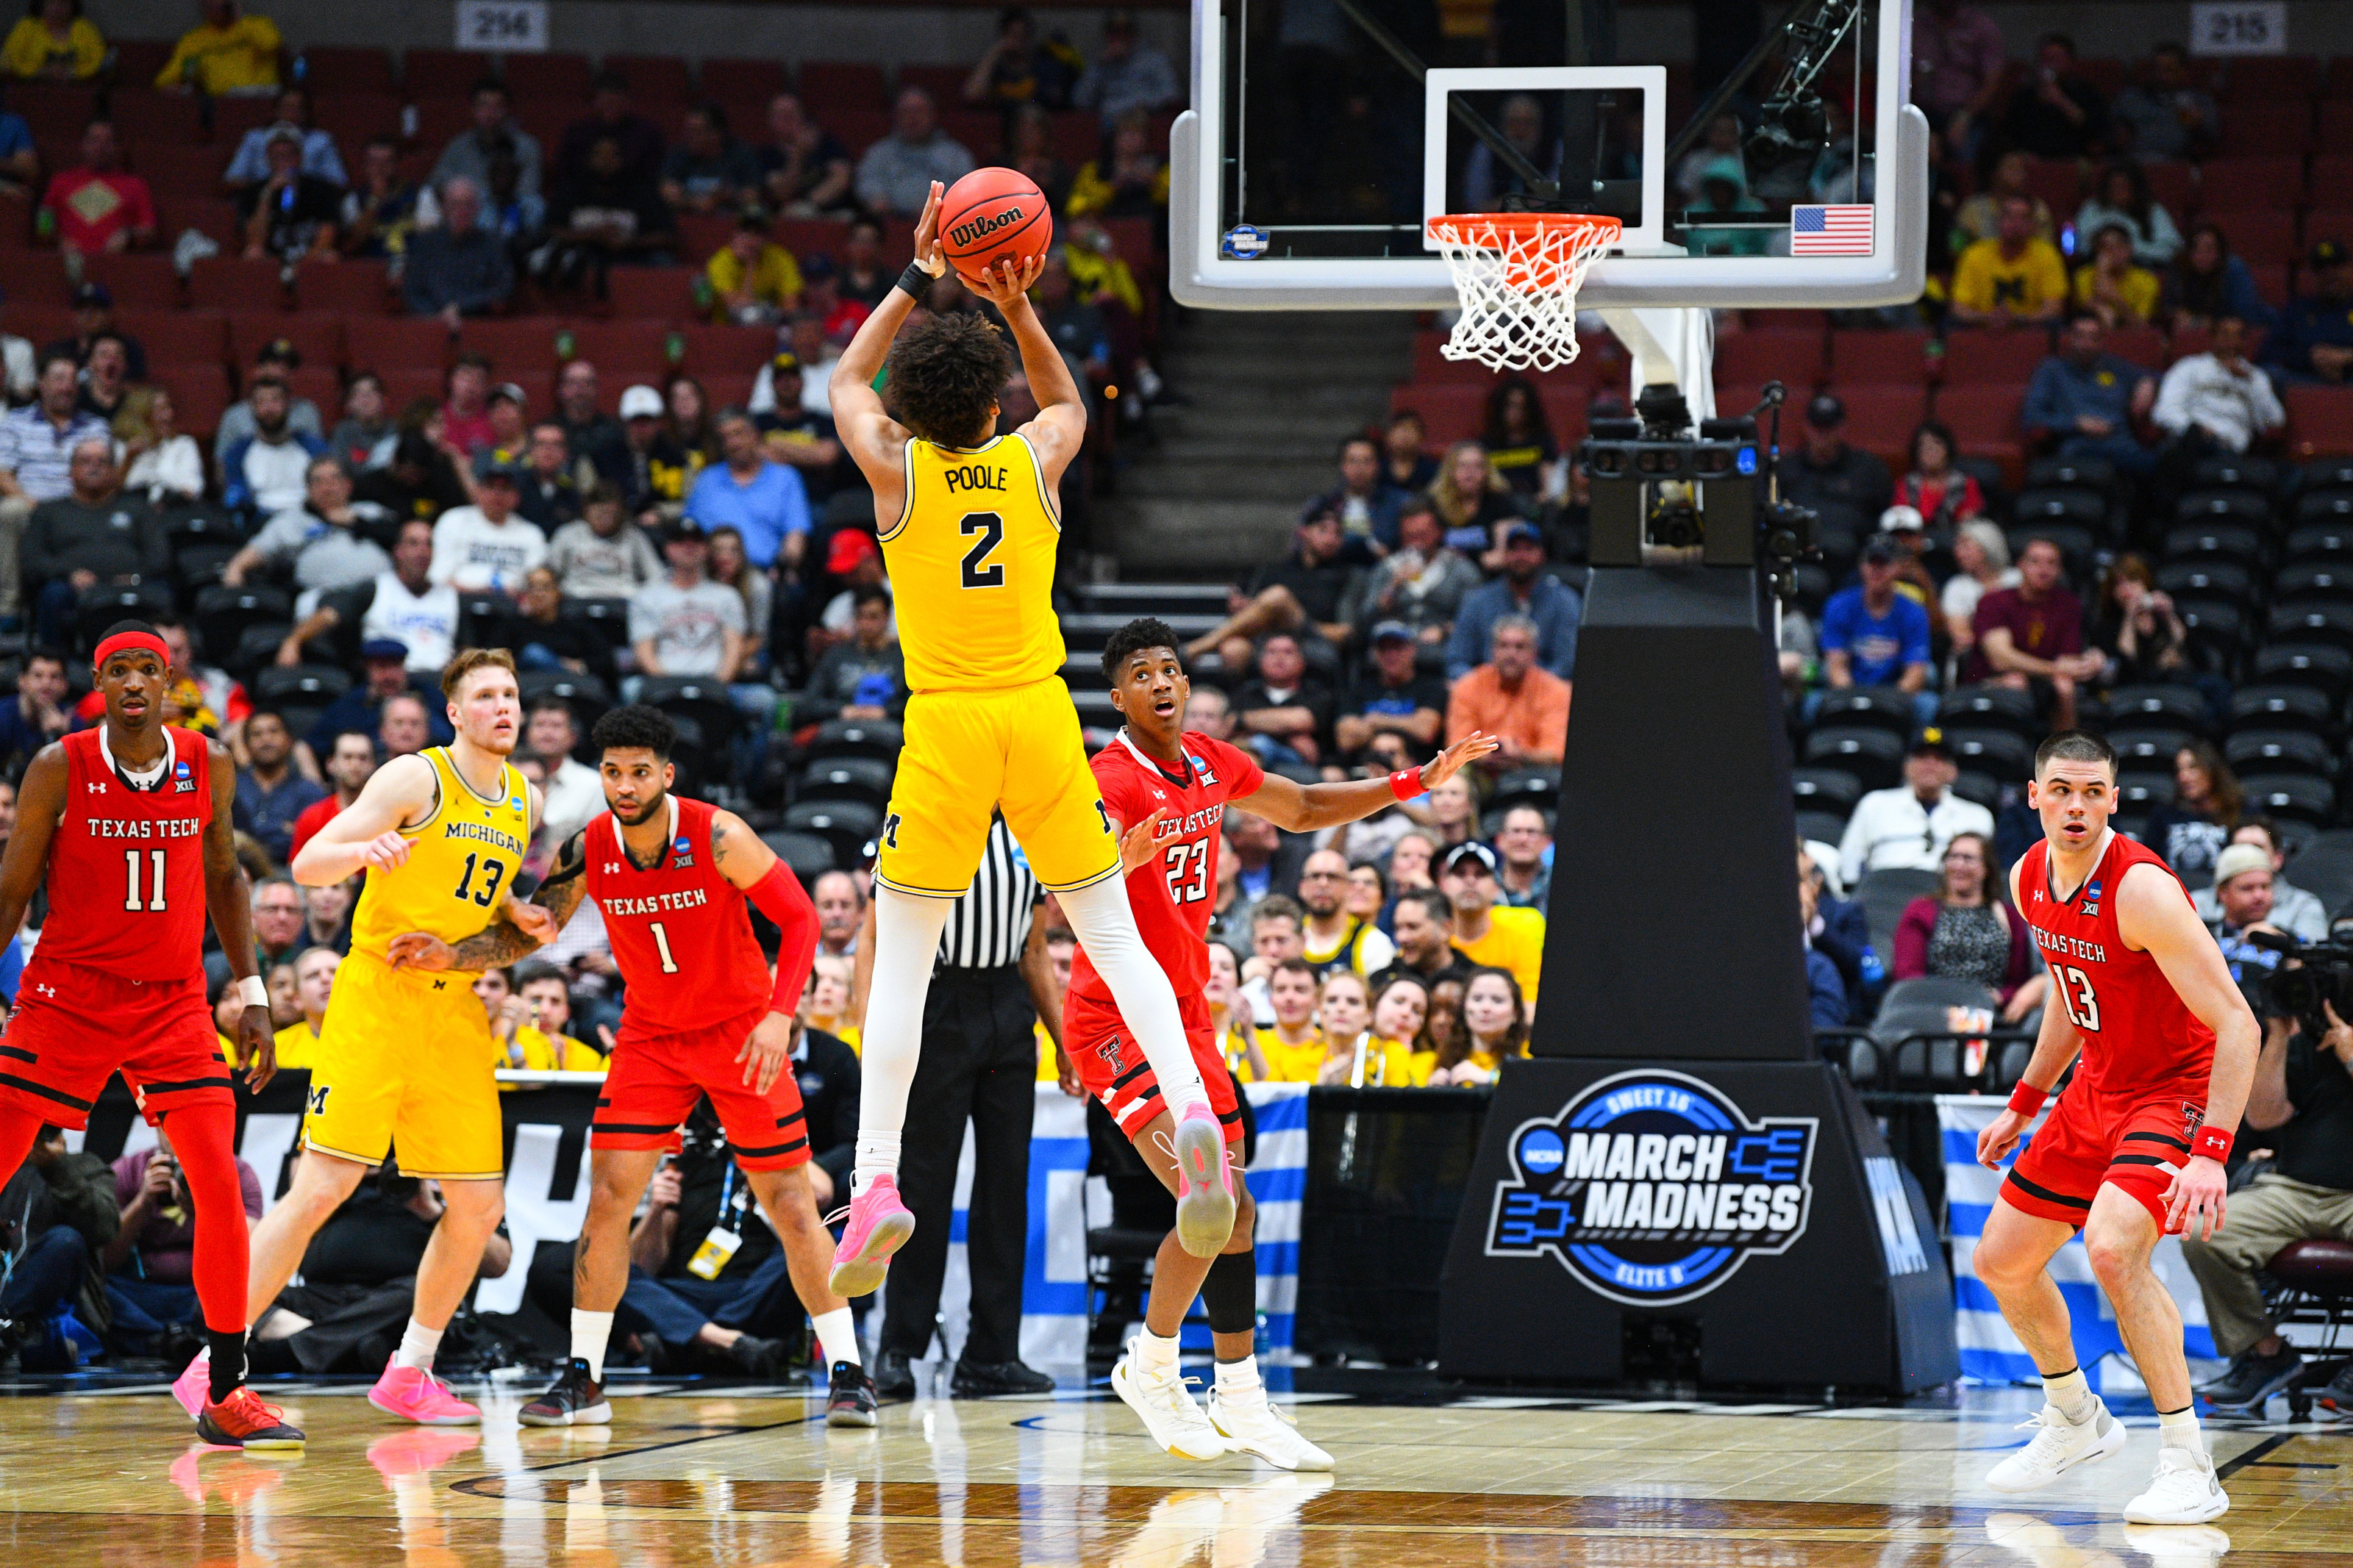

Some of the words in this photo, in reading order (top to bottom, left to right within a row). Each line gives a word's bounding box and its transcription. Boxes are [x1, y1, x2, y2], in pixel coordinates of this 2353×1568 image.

[2210, 11, 2267, 43] 215
[950, 207, 1024, 248] Wilson
[944, 465, 1007, 493] POOLE
[959, 511, 1004, 589] 2
[88, 818, 151, 838] TEXAS
[156, 817, 199, 838] TECH
[1157, 812, 1197, 837] TEXAS
[1196, 801, 1224, 829] TECH
[444, 822, 524, 857] MICHIGAN
[124, 848, 166, 912] 11
[454, 852, 504, 908] 13
[1165, 836, 1209, 906] 23
[602, 895, 658, 915] TEXAS
[660, 887, 707, 911] TECH
[649, 921, 679, 973] 1
[2031, 923, 2068, 953] TEXAS
[2068, 937, 2107, 963] TECH
[2050, 962, 2101, 1033] 13
[1606, 1088, 1665, 1115] SWEET
[1667, 1091, 1690, 1113] 16
[1524, 1149, 1563, 1164] NCAA
[1564, 1132, 1727, 1181] MARCH
[1582, 1181, 1802, 1232] MADNESS
[1615, 1262, 1667, 1289] ELITE
[1669, 1264, 1684, 1284] 8
